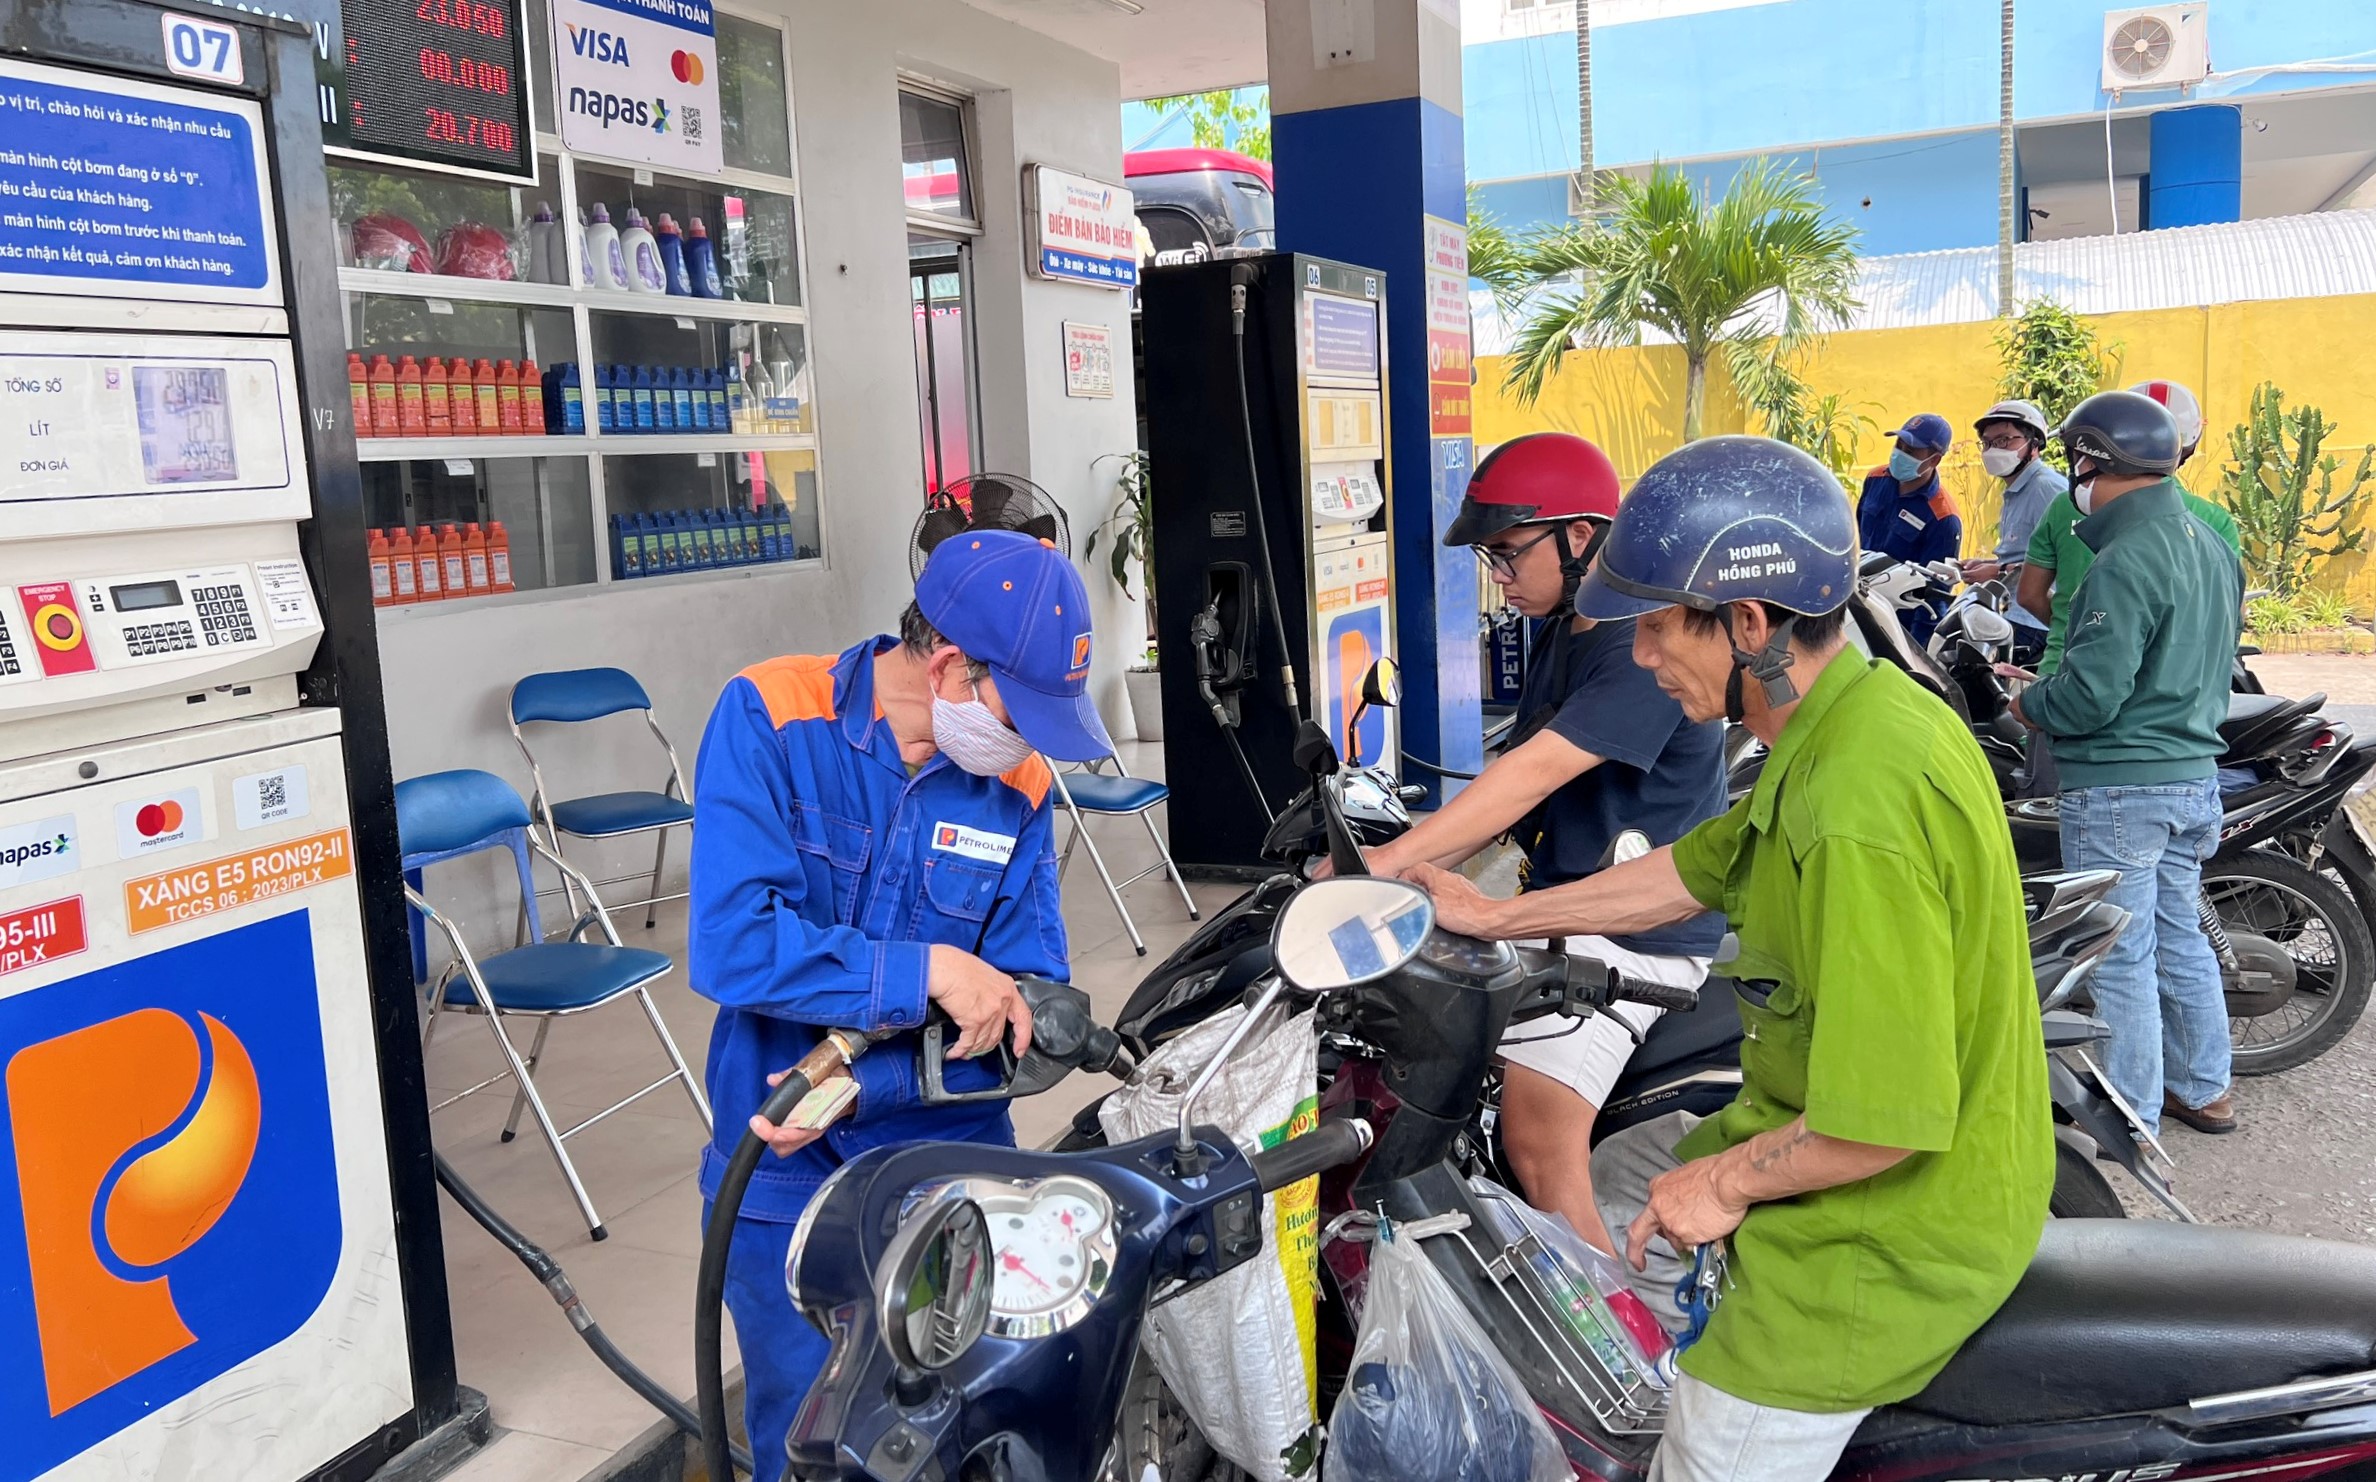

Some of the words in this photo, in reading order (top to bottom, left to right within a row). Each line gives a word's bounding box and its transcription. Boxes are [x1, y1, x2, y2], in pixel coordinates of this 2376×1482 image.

[676, 3, 710, 25] TOÁN
[172, 23, 230, 73] 07
[315, 21, 329, 60] V
[564, 23, 630, 67] VISA
[9, 94, 22, 112] vị
[48, 101, 81, 117] chào
[84, 104, 105, 120] hỏi
[107, 109, 123, 123] và
[126, 112, 148, 126] xác
[151, 116, 182, 133] nhận
[185, 120, 207, 135] nhu
[210, 122, 231, 139] cầu
[569, 87, 648, 129] napas
[425, 108, 512, 153] 20.700
[28, 152, 58, 170] hình
[61, 157, 82, 175] cột
[85, 159, 114, 176] bơm
[117, 164, 148, 183] đang
[151, 167, 160, 181] ở
[163, 167, 178, 183] số
[22, 180, 47, 198] cầu
[50, 185, 74, 201] của
[77, 188, 115, 206] khách
[118, 193, 152, 212] hàng.
[4, 213, 33, 228] màn
[36, 215, 66, 231] hình
[69, 218, 90, 235] cột
[92, 219, 121, 236] bơm
[125, 223, 159, 239] trước
[162, 226, 180, 241] khi
[182, 229, 216, 244] thanh
[218, 233, 247, 247] toán.
[1048, 207, 1072, 237] ĐIỂM
[1075, 215, 1092, 242] BÁN
[1094, 217, 1111, 245] BẢO
[1113, 222, 1132, 249] HIỂM
[26, 245, 59, 263] nhận
[62, 244, 82, 262] kết
[85, 250, 113, 267] quả,
[116, 252, 142, 267] cảm
[145, 256, 161, 268] ơn
[164, 255, 200, 271] khách
[202, 258, 234, 276] hàng.
[1309, 268, 1319, 284] 06
[1366, 280, 1375, 295] 05
[5, 376, 41, 393] TỔNG
[46, 377, 62, 393] SỐ
[29, 420, 50, 437] LÍT
[313, 408, 335, 431] V7
[1441, 440, 1464, 469] VISA
[2074, 435, 2111, 460] Vespa
[20, 462, 46, 472] ĐƠN
[48, 457, 69, 471] GIÁ
[1729, 543, 1782, 561] HONDA
[1718, 563, 1761, 581] HỒNG
[1766, 558, 1796, 576] PHÚ
[38, 594, 56, 602] STOP
[194, 590, 201, 600] 7
[208, 588, 215, 598] 8
[220, 588, 228, 597] 9
[200, 606, 207, 614] 4
[212, 604, 219, 613] 5
[225, 602, 232, 612] 6
[124, 631, 135, 639] P1
[138, 629, 150, 637] P2
[153, 627, 164, 635] P3
[167, 625, 177, 633] P4
[180, 623, 190, 631] P5
[203, 620, 211, 629] 1
[216, 618, 224, 628] 2
[229, 616, 237, 626] 3
[208, 635, 215, 645] 0
[221, 632, 230, 642] C
[7, 663, 17, 671] F4
[261, 810, 273, 820] QR
[274, 808, 288, 818] CODE
[140, 831, 184, 847] mastercard
[136, 871, 209, 909] XĂNG
[217, 860, 246, 888] E5
[252, 837, 343, 877] RON92-II
[166, 898, 214, 922] TCCS
[219, 892, 238, 909] 06
[252, 868, 322, 898] 2023/PLX
[1606, 1102, 1638, 1115] BLACK
[1641, 1090, 1679, 1105] EDITION
